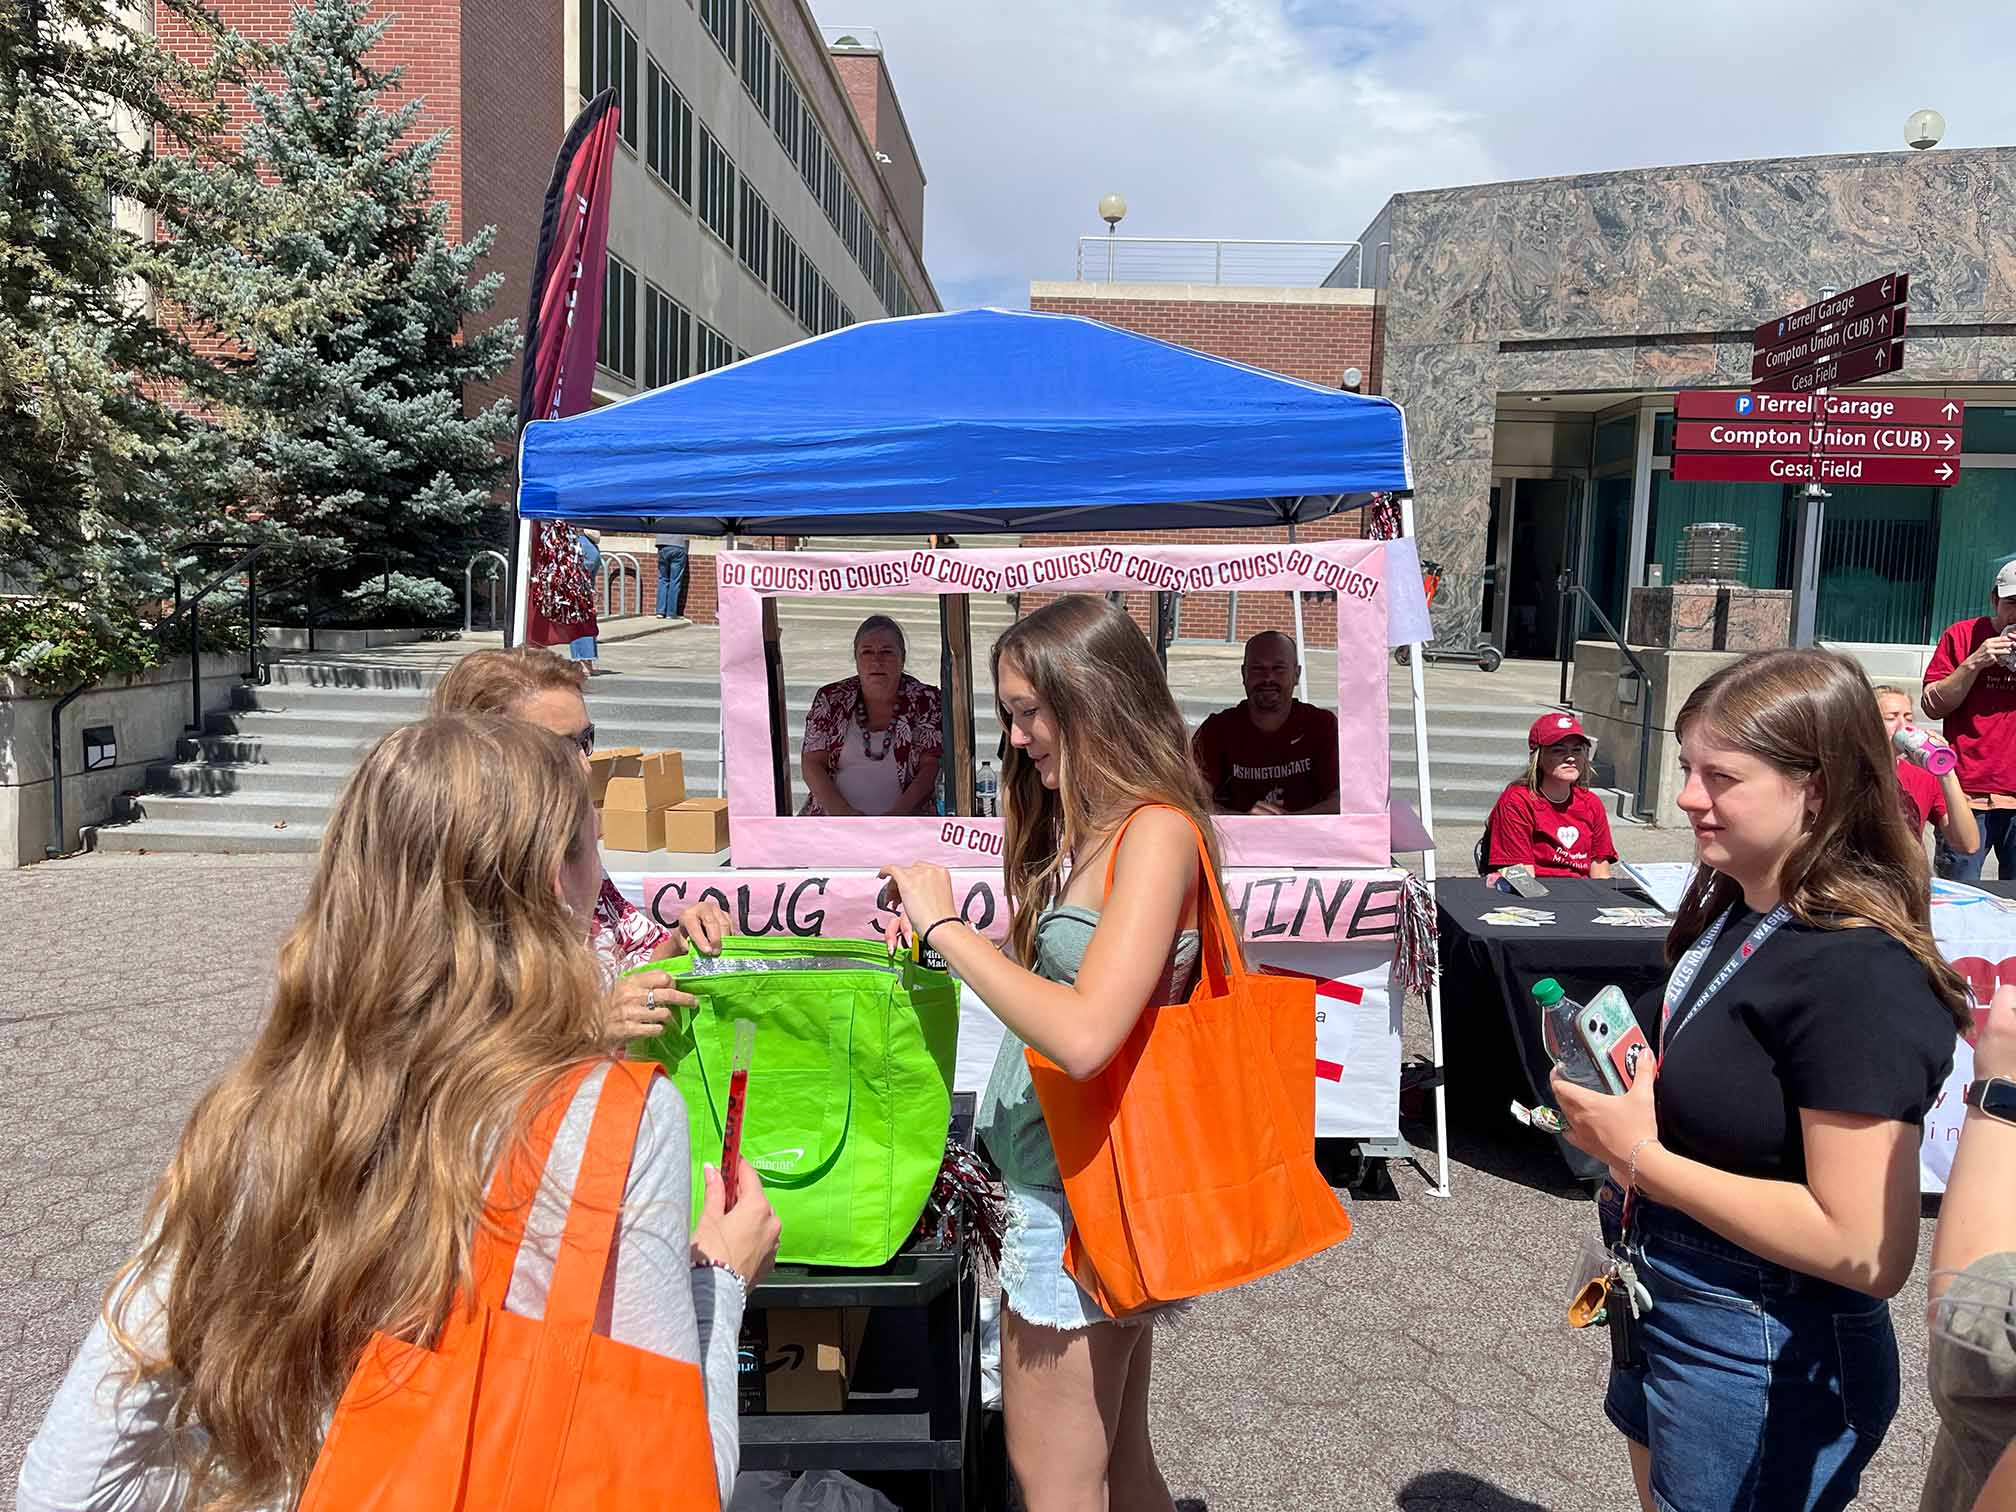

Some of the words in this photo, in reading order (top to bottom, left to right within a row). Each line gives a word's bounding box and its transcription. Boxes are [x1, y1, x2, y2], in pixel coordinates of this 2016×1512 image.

[1787, 306, 1816, 332] Terrell
[1819, 296, 1855, 319] Garage
[1766, 344, 1808, 368] Compton
[1810, 332, 1840, 353] Union
[1842, 316, 1874, 345] (CUB)
[1791, 375, 1813, 391] Gesa
[1816, 362, 1838, 384] Field
[1757, 395, 1817, 413] Terrell
[1824, 397, 1894, 419] Garage
[1710, 426, 1801, 449] Compton
[1809, 428, 1866, 446] Union
[1873, 429, 1930, 452] (CUB)
[1770, 459, 1814, 477] Gesa
[1821, 460, 1862, 478] Field
[722, 563, 745, 585] GO
[750, 566, 814, 590] COUGS!
[819, 569, 841, 592] GO
[846, 560, 908, 589] COUGS!
[911, 552, 934, 577] GO
[938, 558, 1002, 594] COUGS!
[1005, 564, 1028, 588] GO
[1032, 551, 1097, 582] COUGS!
[1098, 548, 1123, 573] GO
[1126, 556, 1188, 593] COUGS!
[1189, 566, 1213, 590] GO
[1218, 552, 1284, 584] COUGS!
[1286, 549, 1309, 575] GO
[1313, 560, 1379, 601] COUGS!
[1233, 763, 1287, 780] WSHINGTON
[941, 822, 964, 845] GO
[968, 829, 1003, 855] COU
[1230, 876, 1399, 938] HINE
[923, 950, 944, 959] Min
[1688, 911, 1729, 966] HINGTON
[1709, 959, 1739, 992] STATE
[1753, 905, 1788, 940] WASHI
[1668, 966, 1694, 1002] STATE
